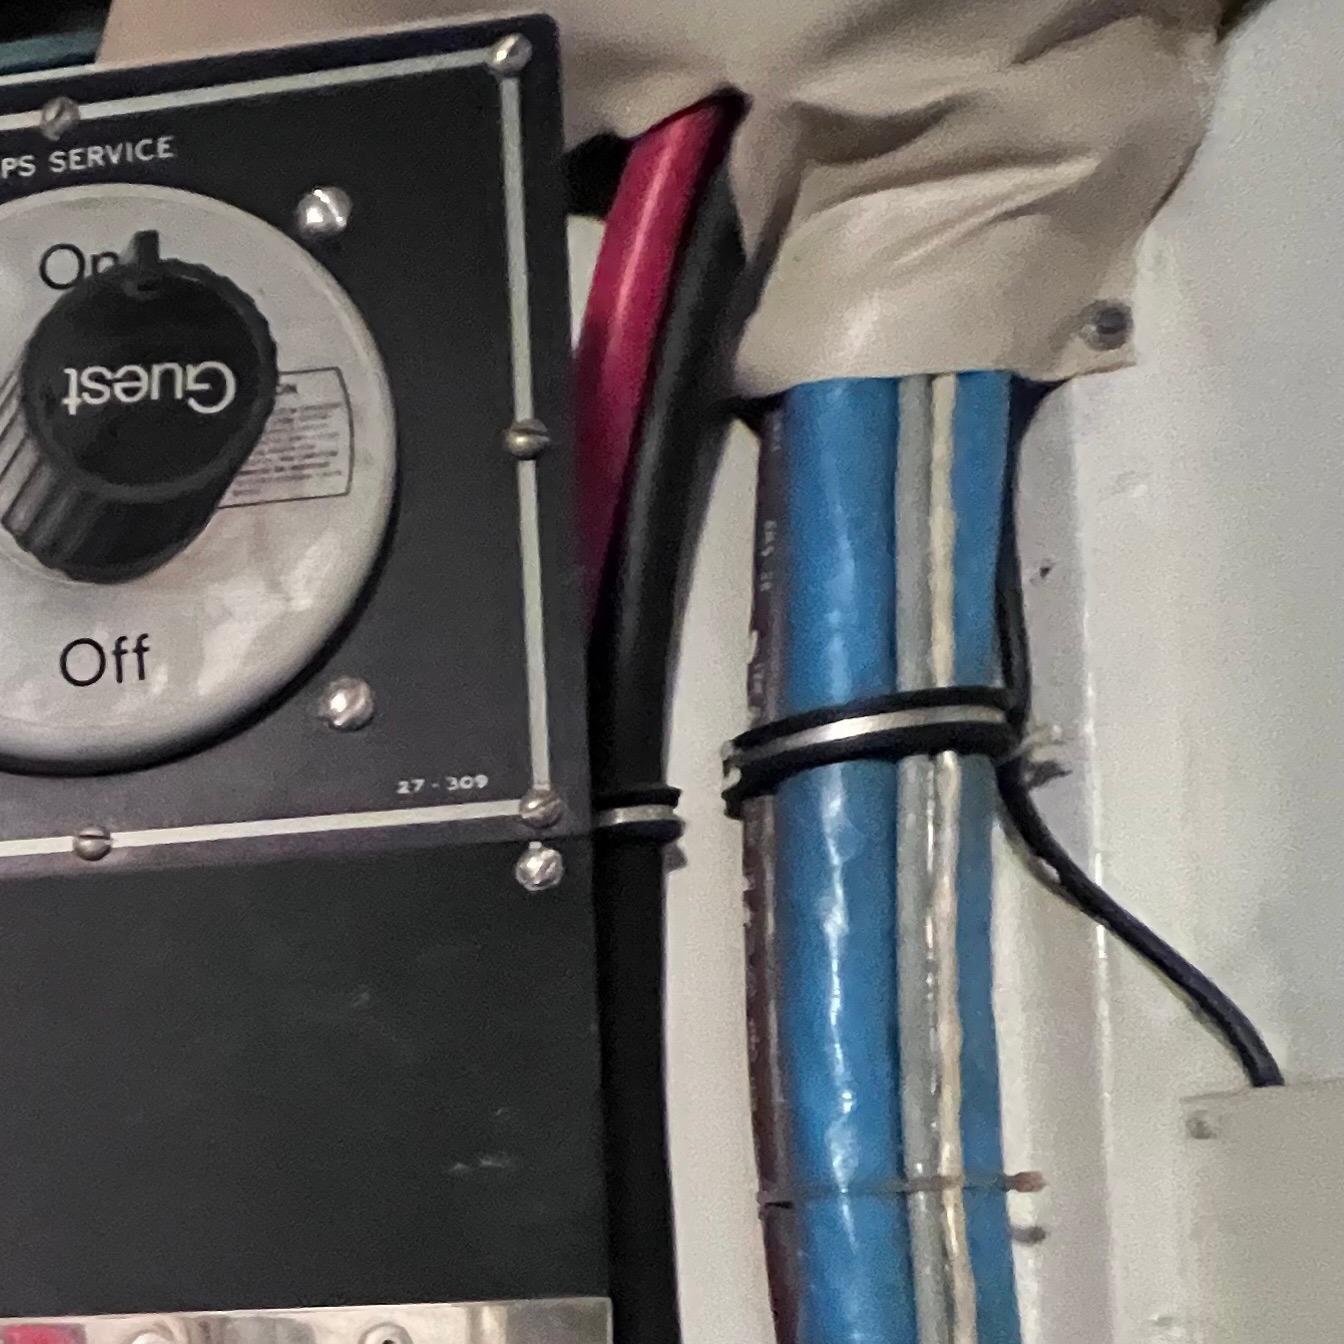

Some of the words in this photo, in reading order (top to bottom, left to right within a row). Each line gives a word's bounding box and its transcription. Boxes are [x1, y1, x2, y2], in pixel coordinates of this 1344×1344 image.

[49, 135, 175, 173] SERVICE
[62, 361, 236, 414] Guest
[59, 633, 150, 687] Off
